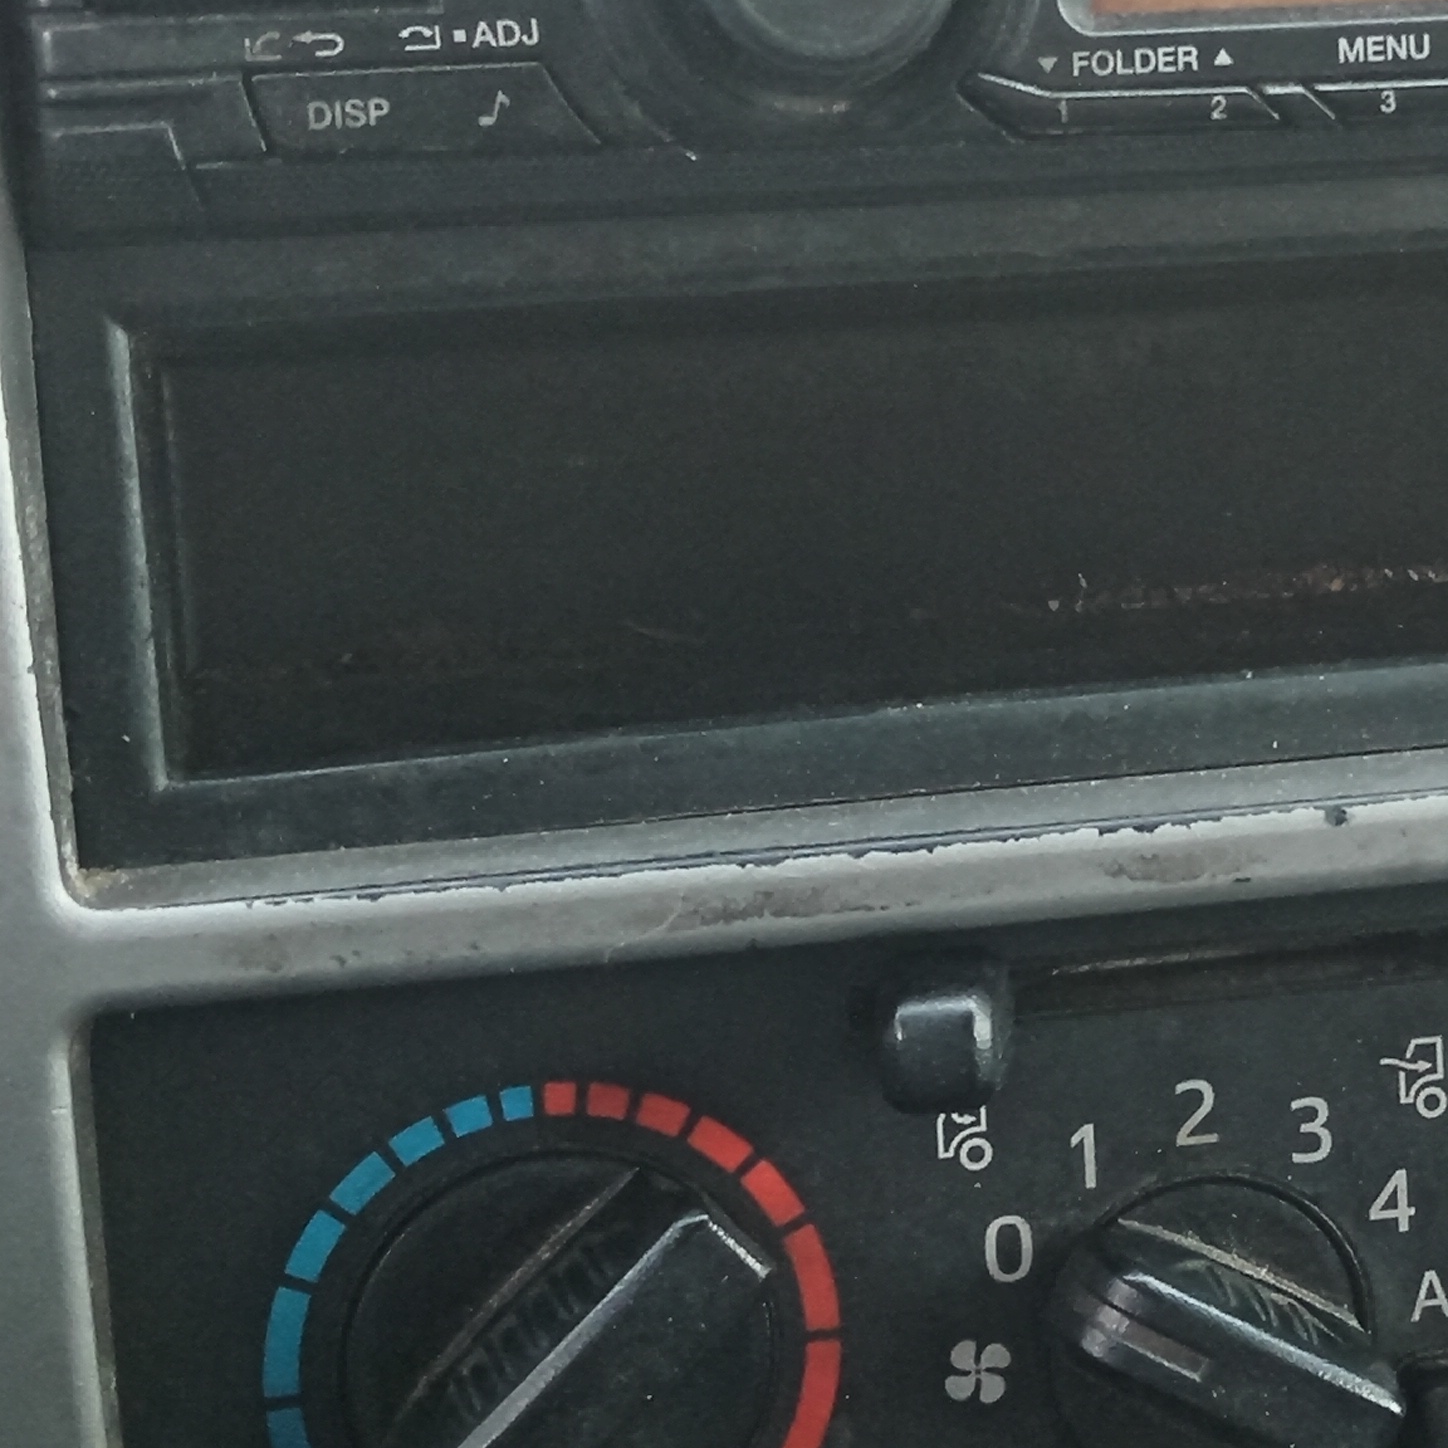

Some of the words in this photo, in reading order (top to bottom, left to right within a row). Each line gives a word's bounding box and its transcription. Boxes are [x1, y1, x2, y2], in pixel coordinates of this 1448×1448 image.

[472, 18, 540, 49] ADJ
[1338, 34, 1431, 64] MENU
[1072, 47, 1198, 77] FOLDER
[307, 98, 390, 131] DISP
[1057, 99, 1069, 123] 1
[1210, 96, 1228, 121] 2
[1380, 89, 1397, 114] 3
[1174, 1079, 1220, 1147] 2
[1290, 1096, 1333, 1164] 3
[1070, 1123, 1097, 1189] 1
[1368, 1168, 1416, 1233] 4
[984, 1215, 1033, 1283] 0
